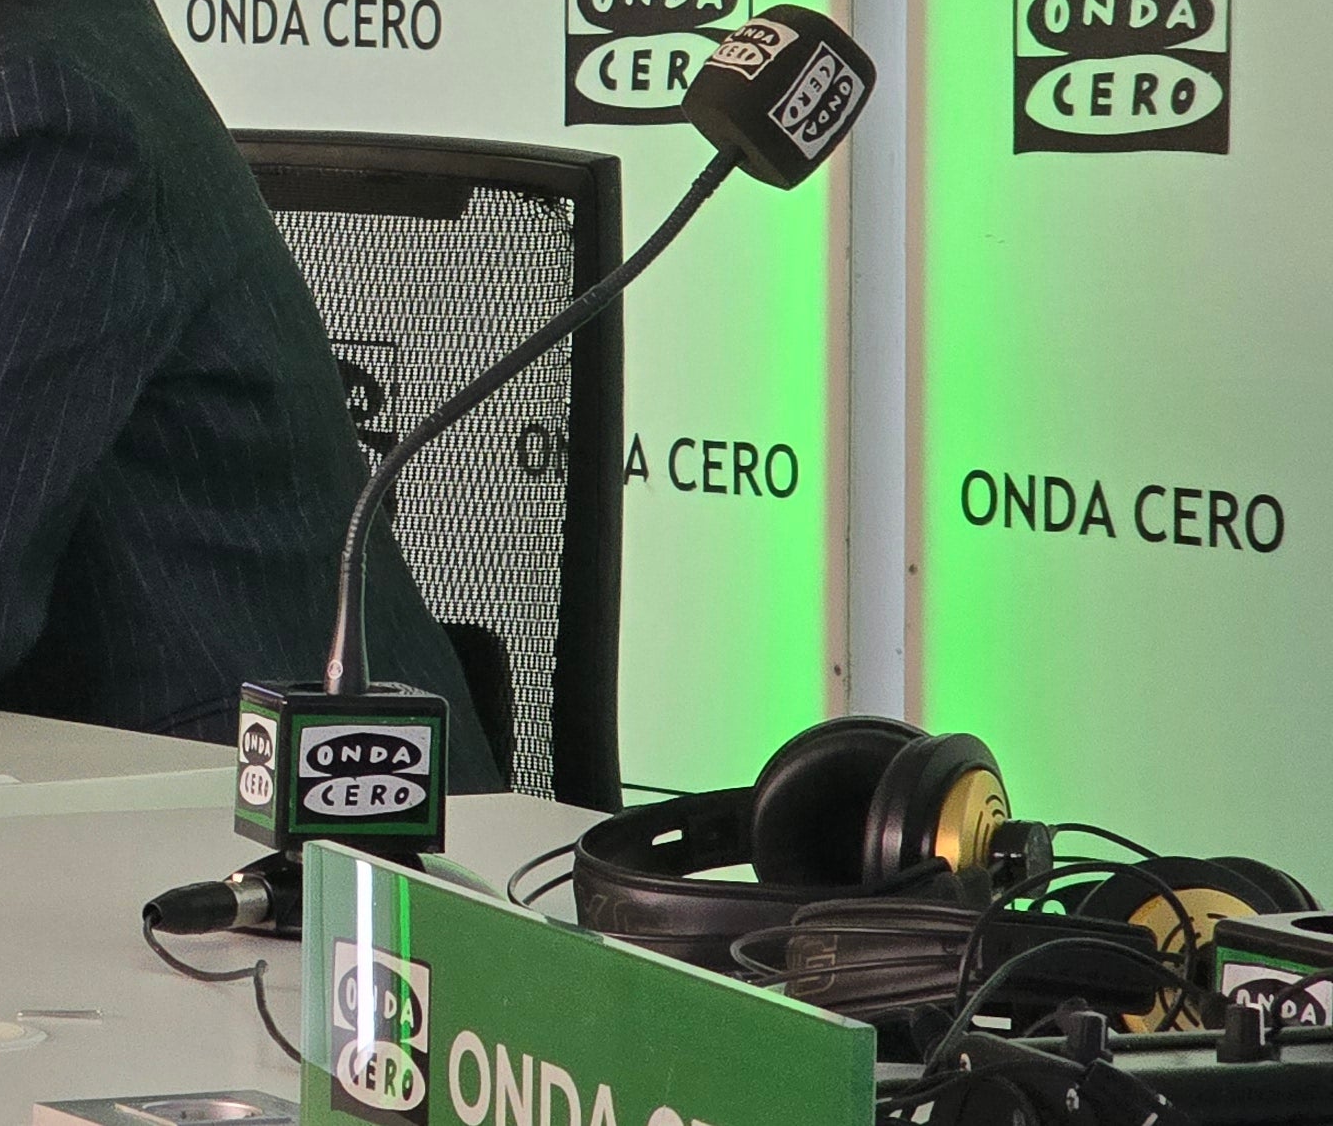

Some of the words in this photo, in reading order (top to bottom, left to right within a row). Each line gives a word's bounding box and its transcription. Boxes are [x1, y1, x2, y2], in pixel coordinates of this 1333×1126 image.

[598, 47, 689, 93] CER
[789, 65, 831, 120] CERO
[805, 79, 851, 136] ONDA
[1053, 72, 1195, 116] CERO
[669, 438, 798, 498] CERO
[961, 470, 1116, 538] ONDA
[1135, 485, 1284, 553] CERO
[243, 732, 272, 757] ONDA
[317, 745, 410, 765] ONDA
[244, 772, 270, 803] CERO
[322, 785, 409, 806] CERO
[346, 977, 415, 1029] ODA
